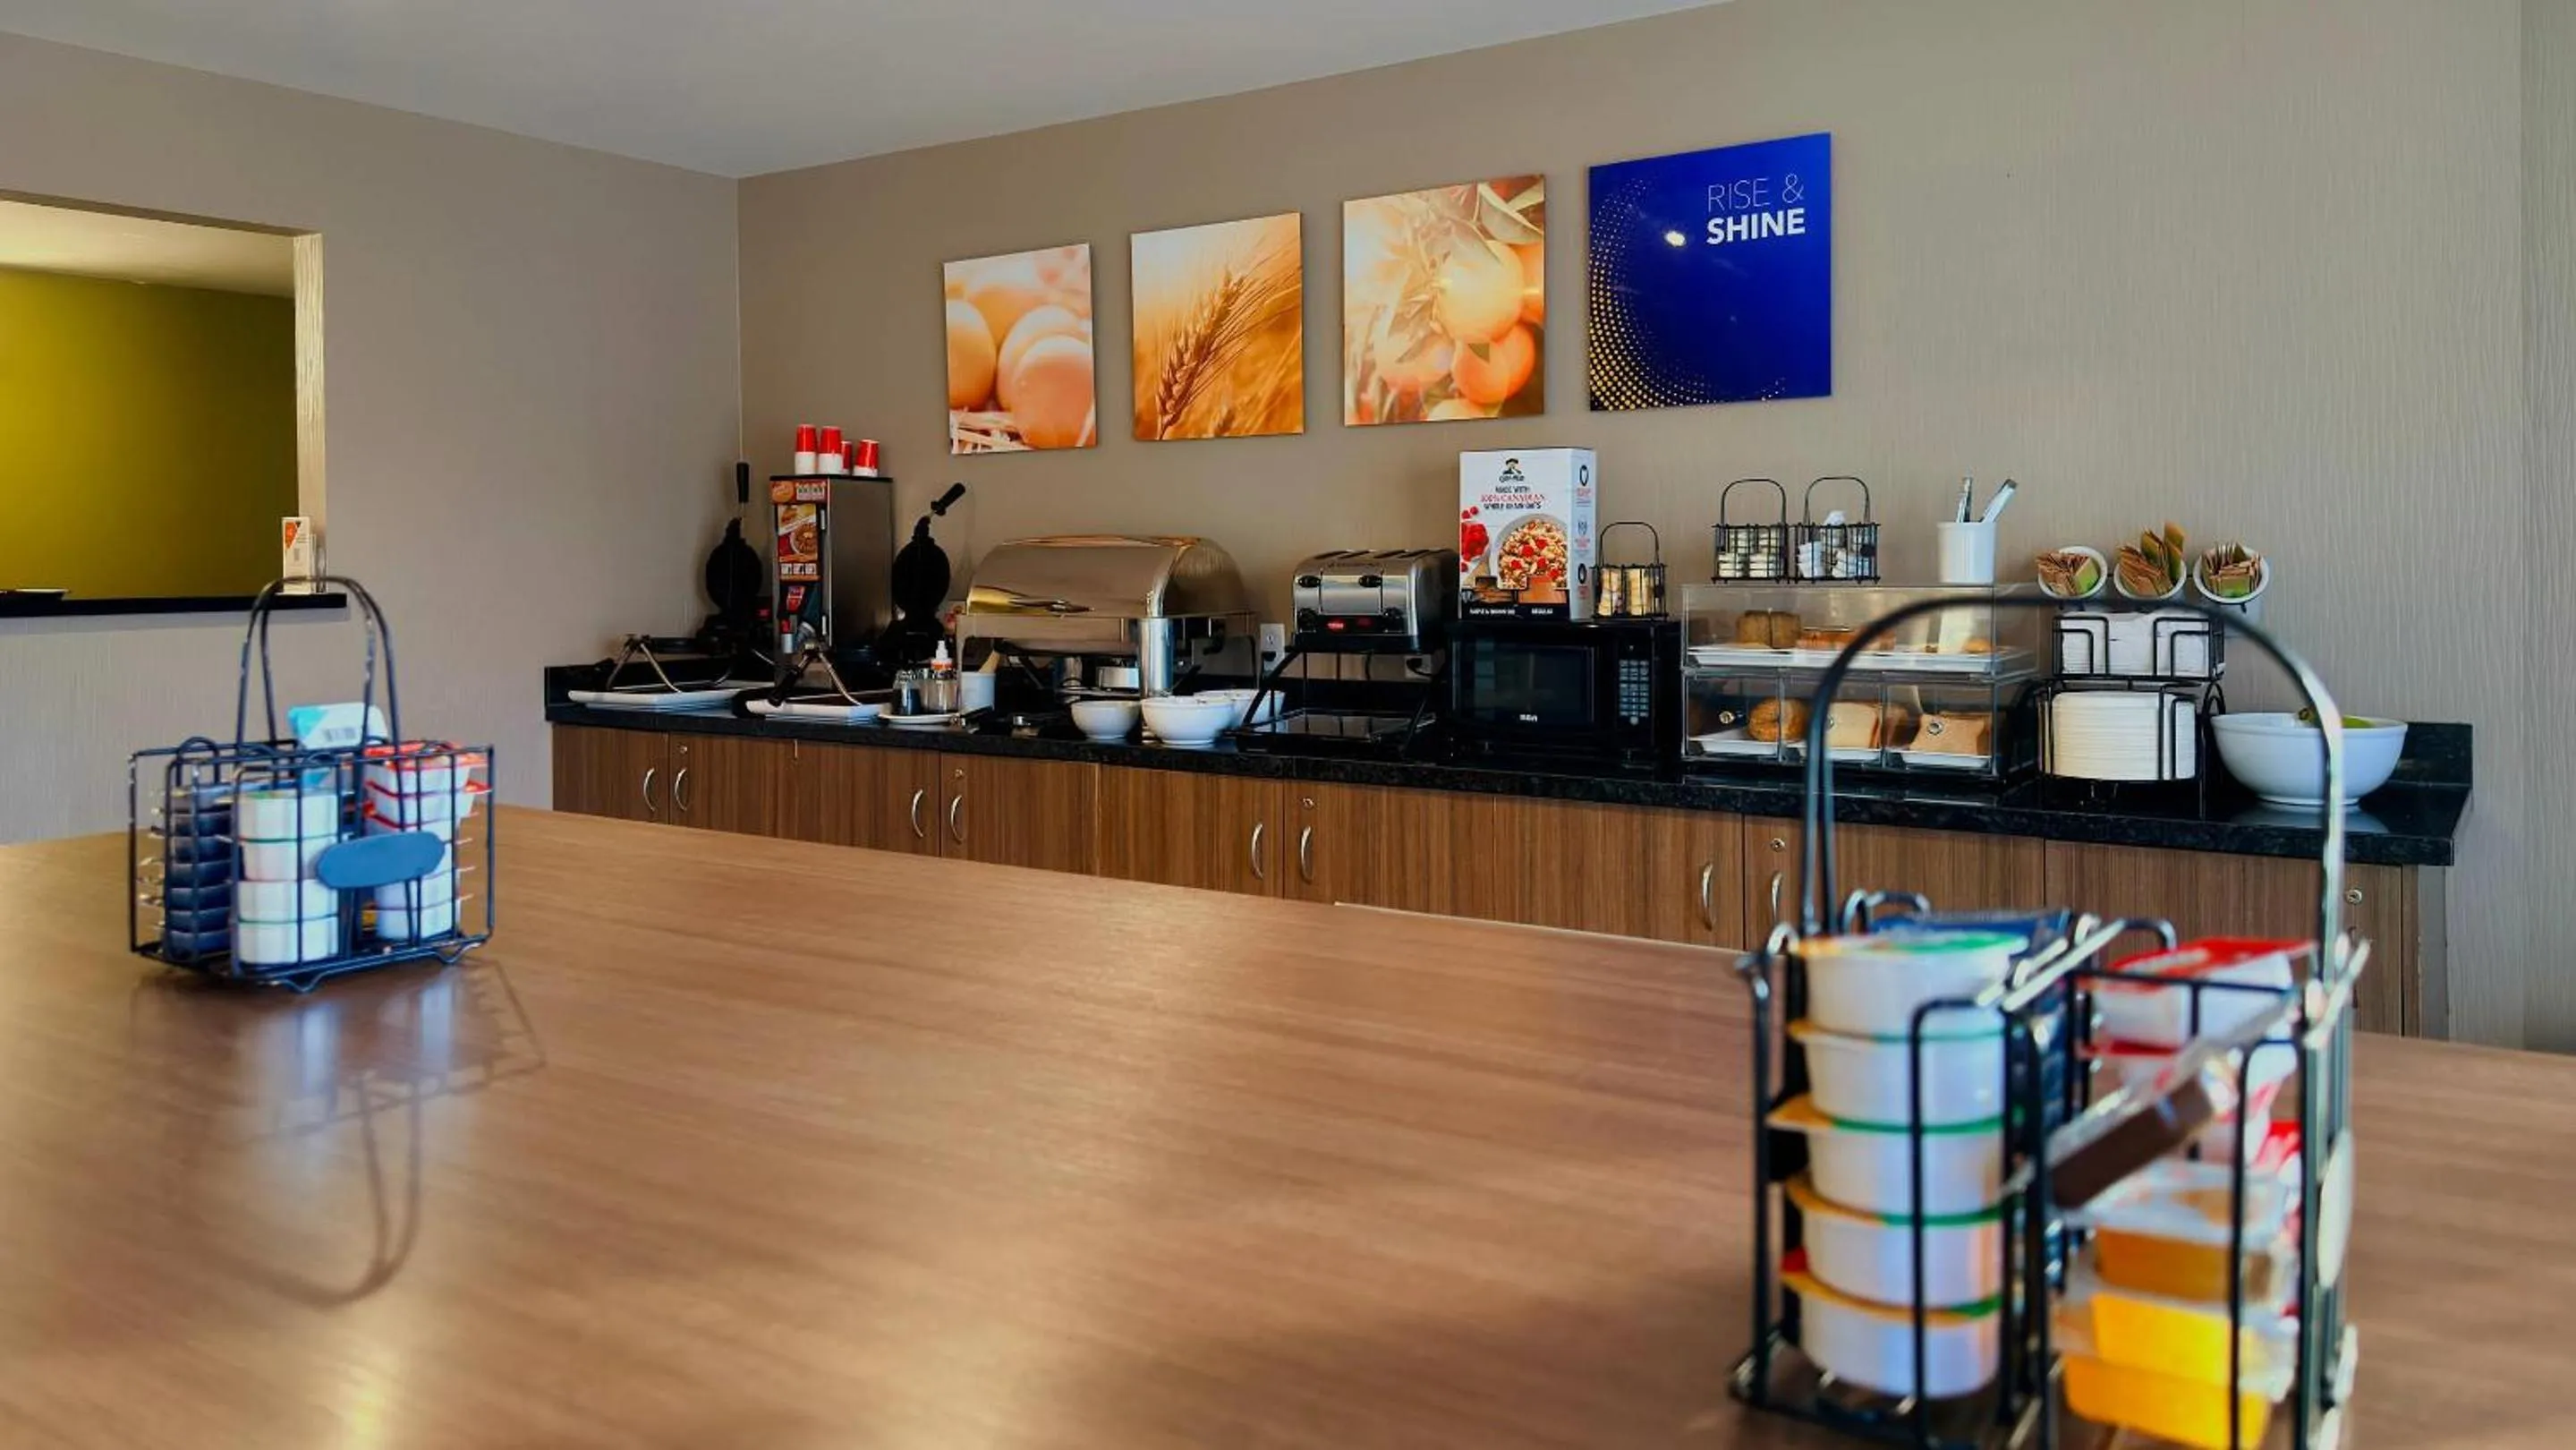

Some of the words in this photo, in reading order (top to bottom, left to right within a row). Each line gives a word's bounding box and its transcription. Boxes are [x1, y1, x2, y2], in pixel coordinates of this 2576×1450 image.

[1708, 178, 1771, 212] RISE
[1781, 174, 1805, 203] &
[1706, 208, 1806, 244] SHINE
